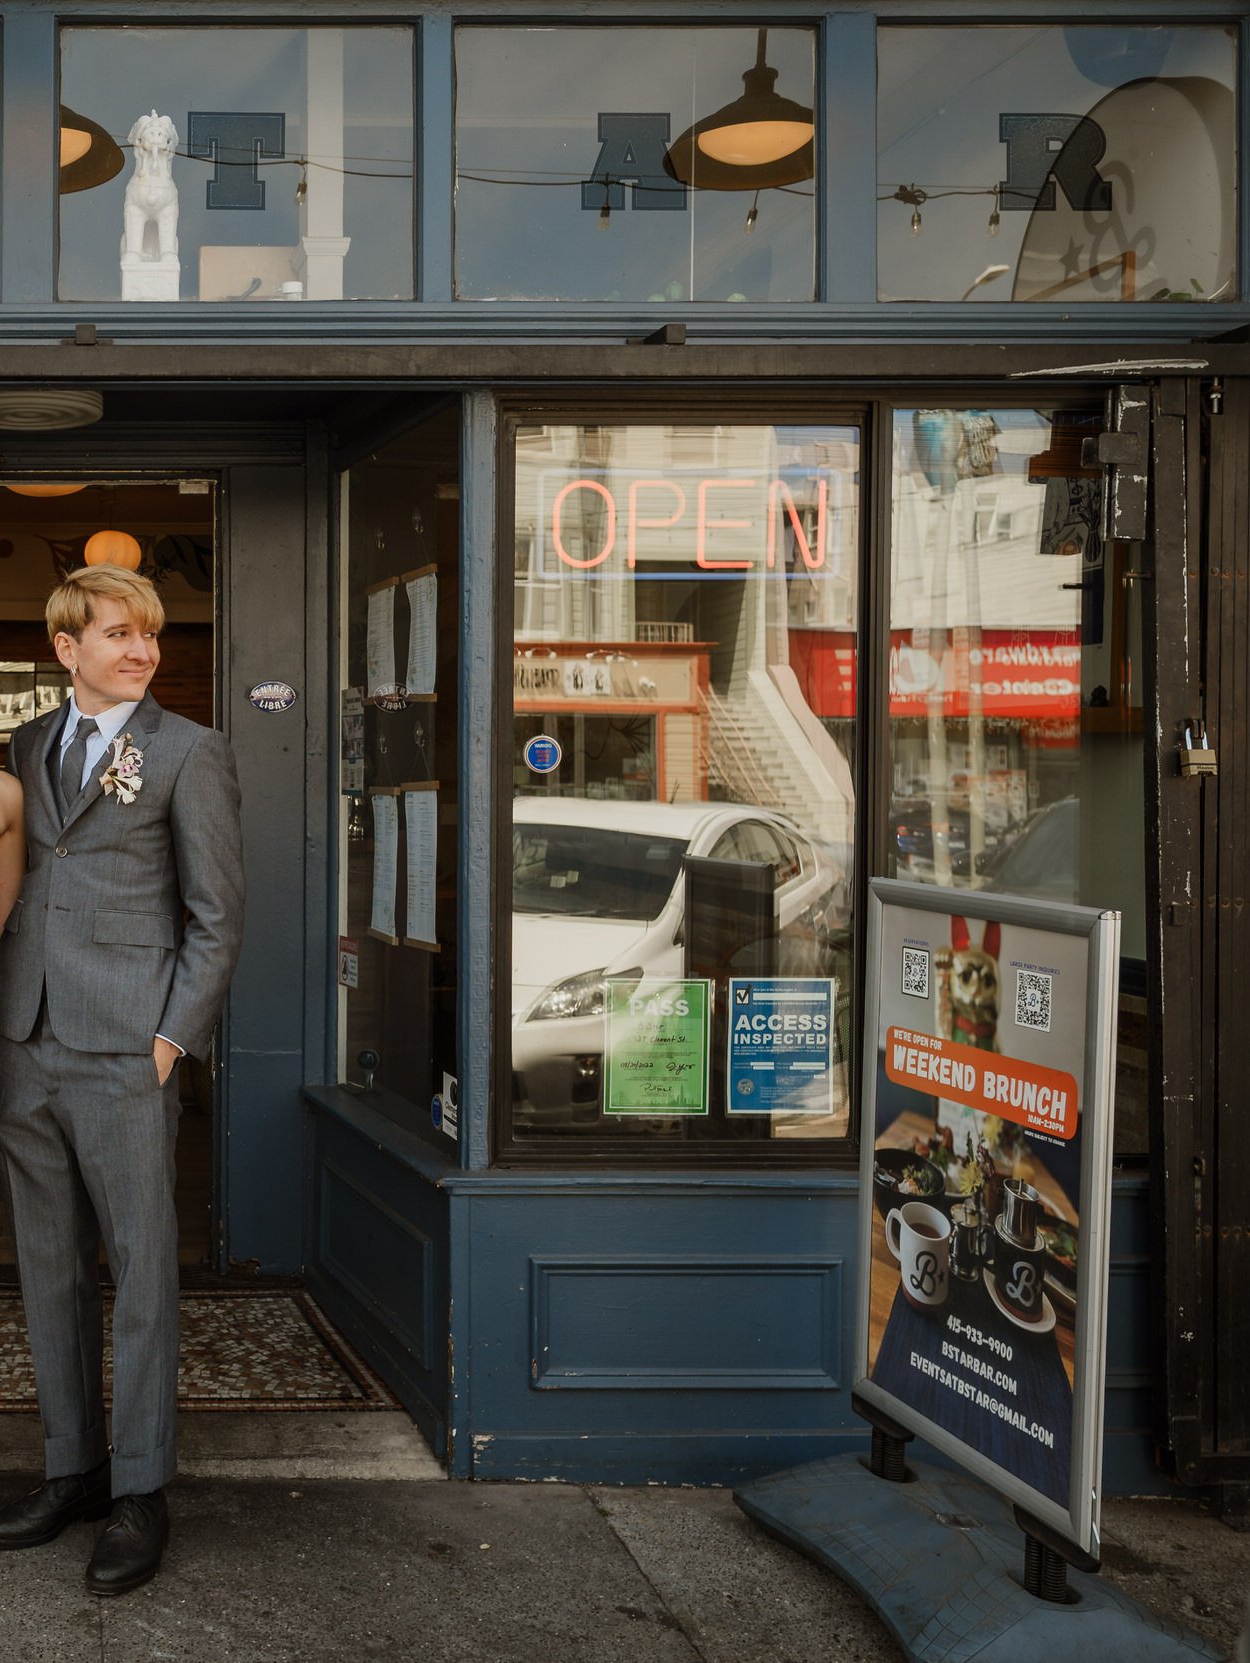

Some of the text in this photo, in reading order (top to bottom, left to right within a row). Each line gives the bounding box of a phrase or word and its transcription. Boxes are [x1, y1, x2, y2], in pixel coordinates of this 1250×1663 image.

[187, 111, 286, 211] T
[581, 112, 688, 211] A
[999, 112, 1113, 211] R
[552, 480, 827, 569] OPEN
[259, 700, 287, 710] LIBRE
[630, 999, 690, 1016] PASS
[735, 1014, 827, 1031] ACCESS
[734, 1033, 827, 1045] INSPECTED
[913, 1034, 929, 1048] OPEN
[930, 1039, 942, 1051] FOR
[893, 1044, 1067, 1122] WEEKEND BRUNCH
[946, 1314, 1013, 1362] 415-933-9900
[941, 1340, 1017, 1396] BSTARBAR.COM
[910, 1351, 1054, 1449] EVENTSATBSTAR@GMAIL.COM
